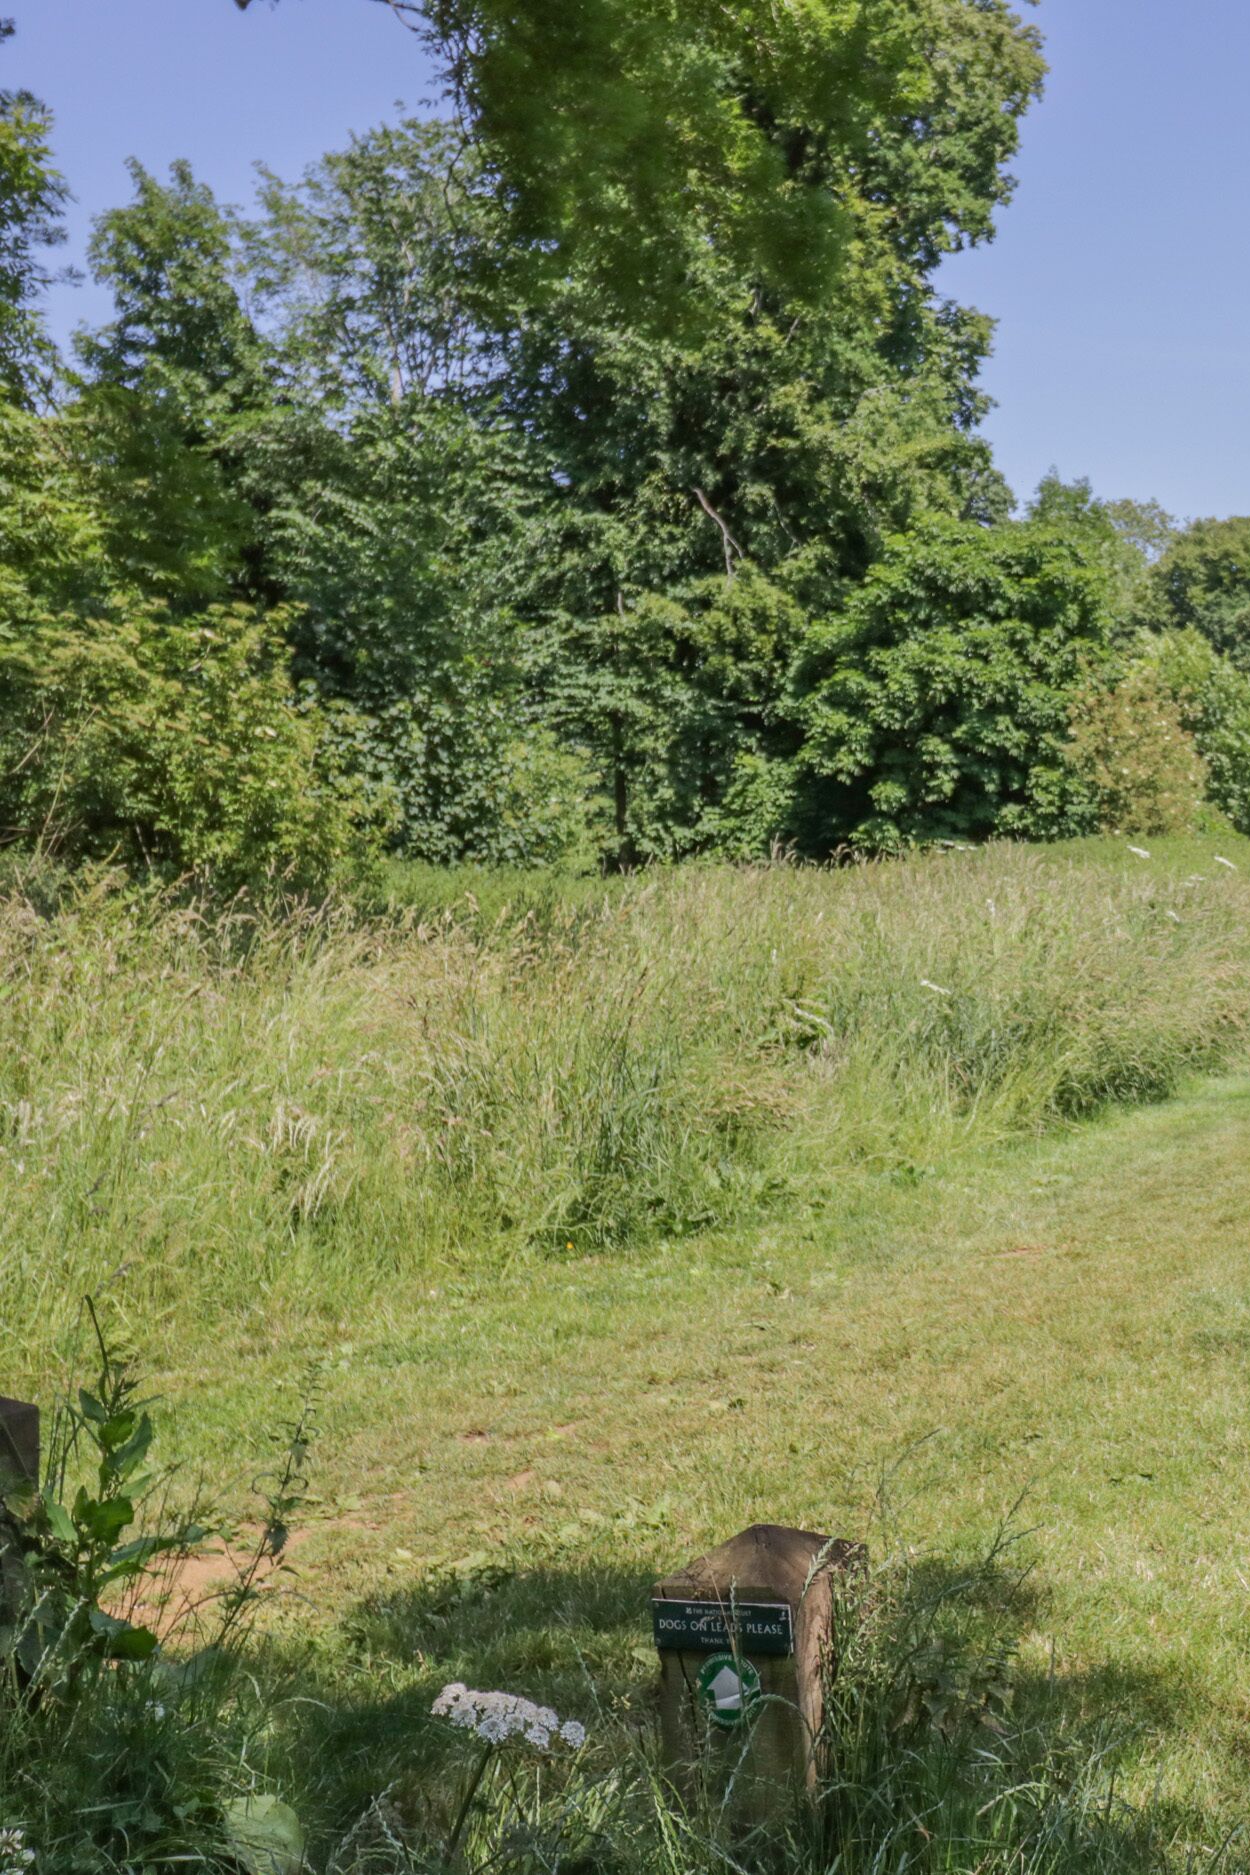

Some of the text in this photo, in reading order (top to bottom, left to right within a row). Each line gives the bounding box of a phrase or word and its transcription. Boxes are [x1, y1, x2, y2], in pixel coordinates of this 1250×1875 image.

[659, 1618, 687, 1631] DOGS
[690, 1620, 707, 1632] ON
[746, 1622, 784, 1635] PLEASE
